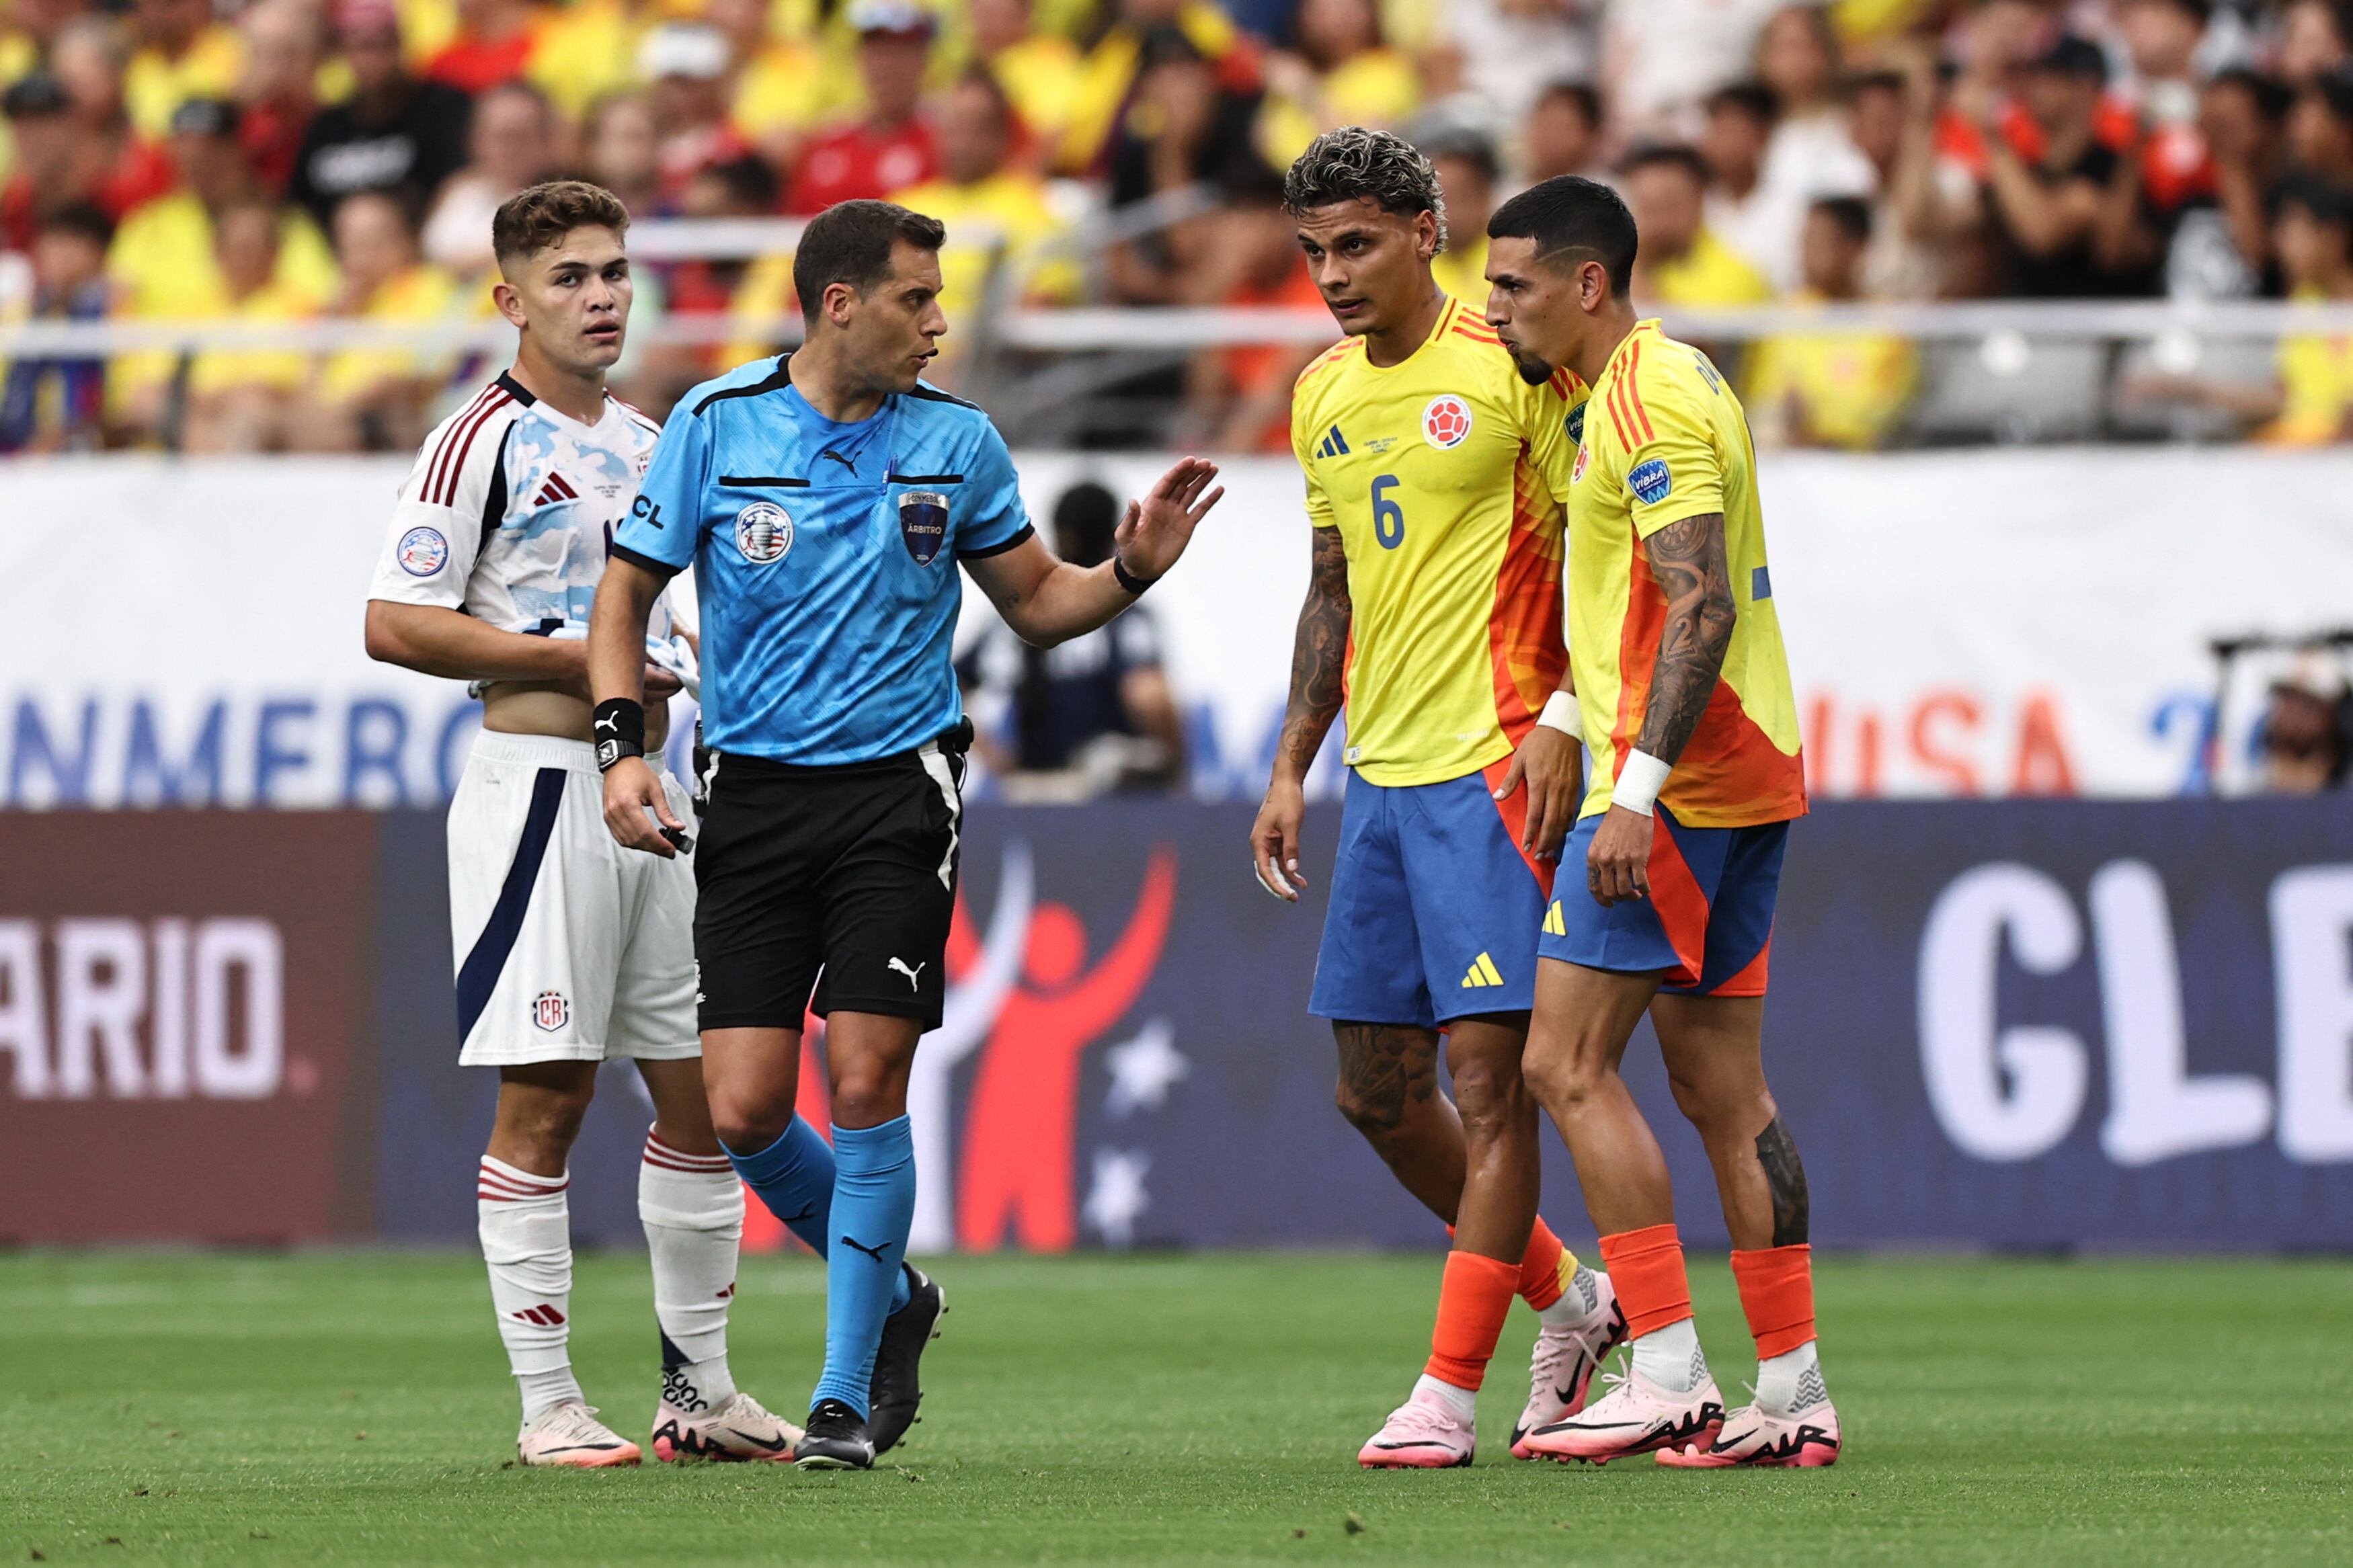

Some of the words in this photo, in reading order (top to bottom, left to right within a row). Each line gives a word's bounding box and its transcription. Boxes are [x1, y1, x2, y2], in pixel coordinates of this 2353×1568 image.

[1635, 469, 1665, 490] VIBRA
[632, 494, 665, 530] CL
[1371, 474, 1404, 550] 6
[908, 522, 942, 534] ÁRBITRO
[1803, 687, 2082, 798] USA
[541, 999, 561, 1026] CR
